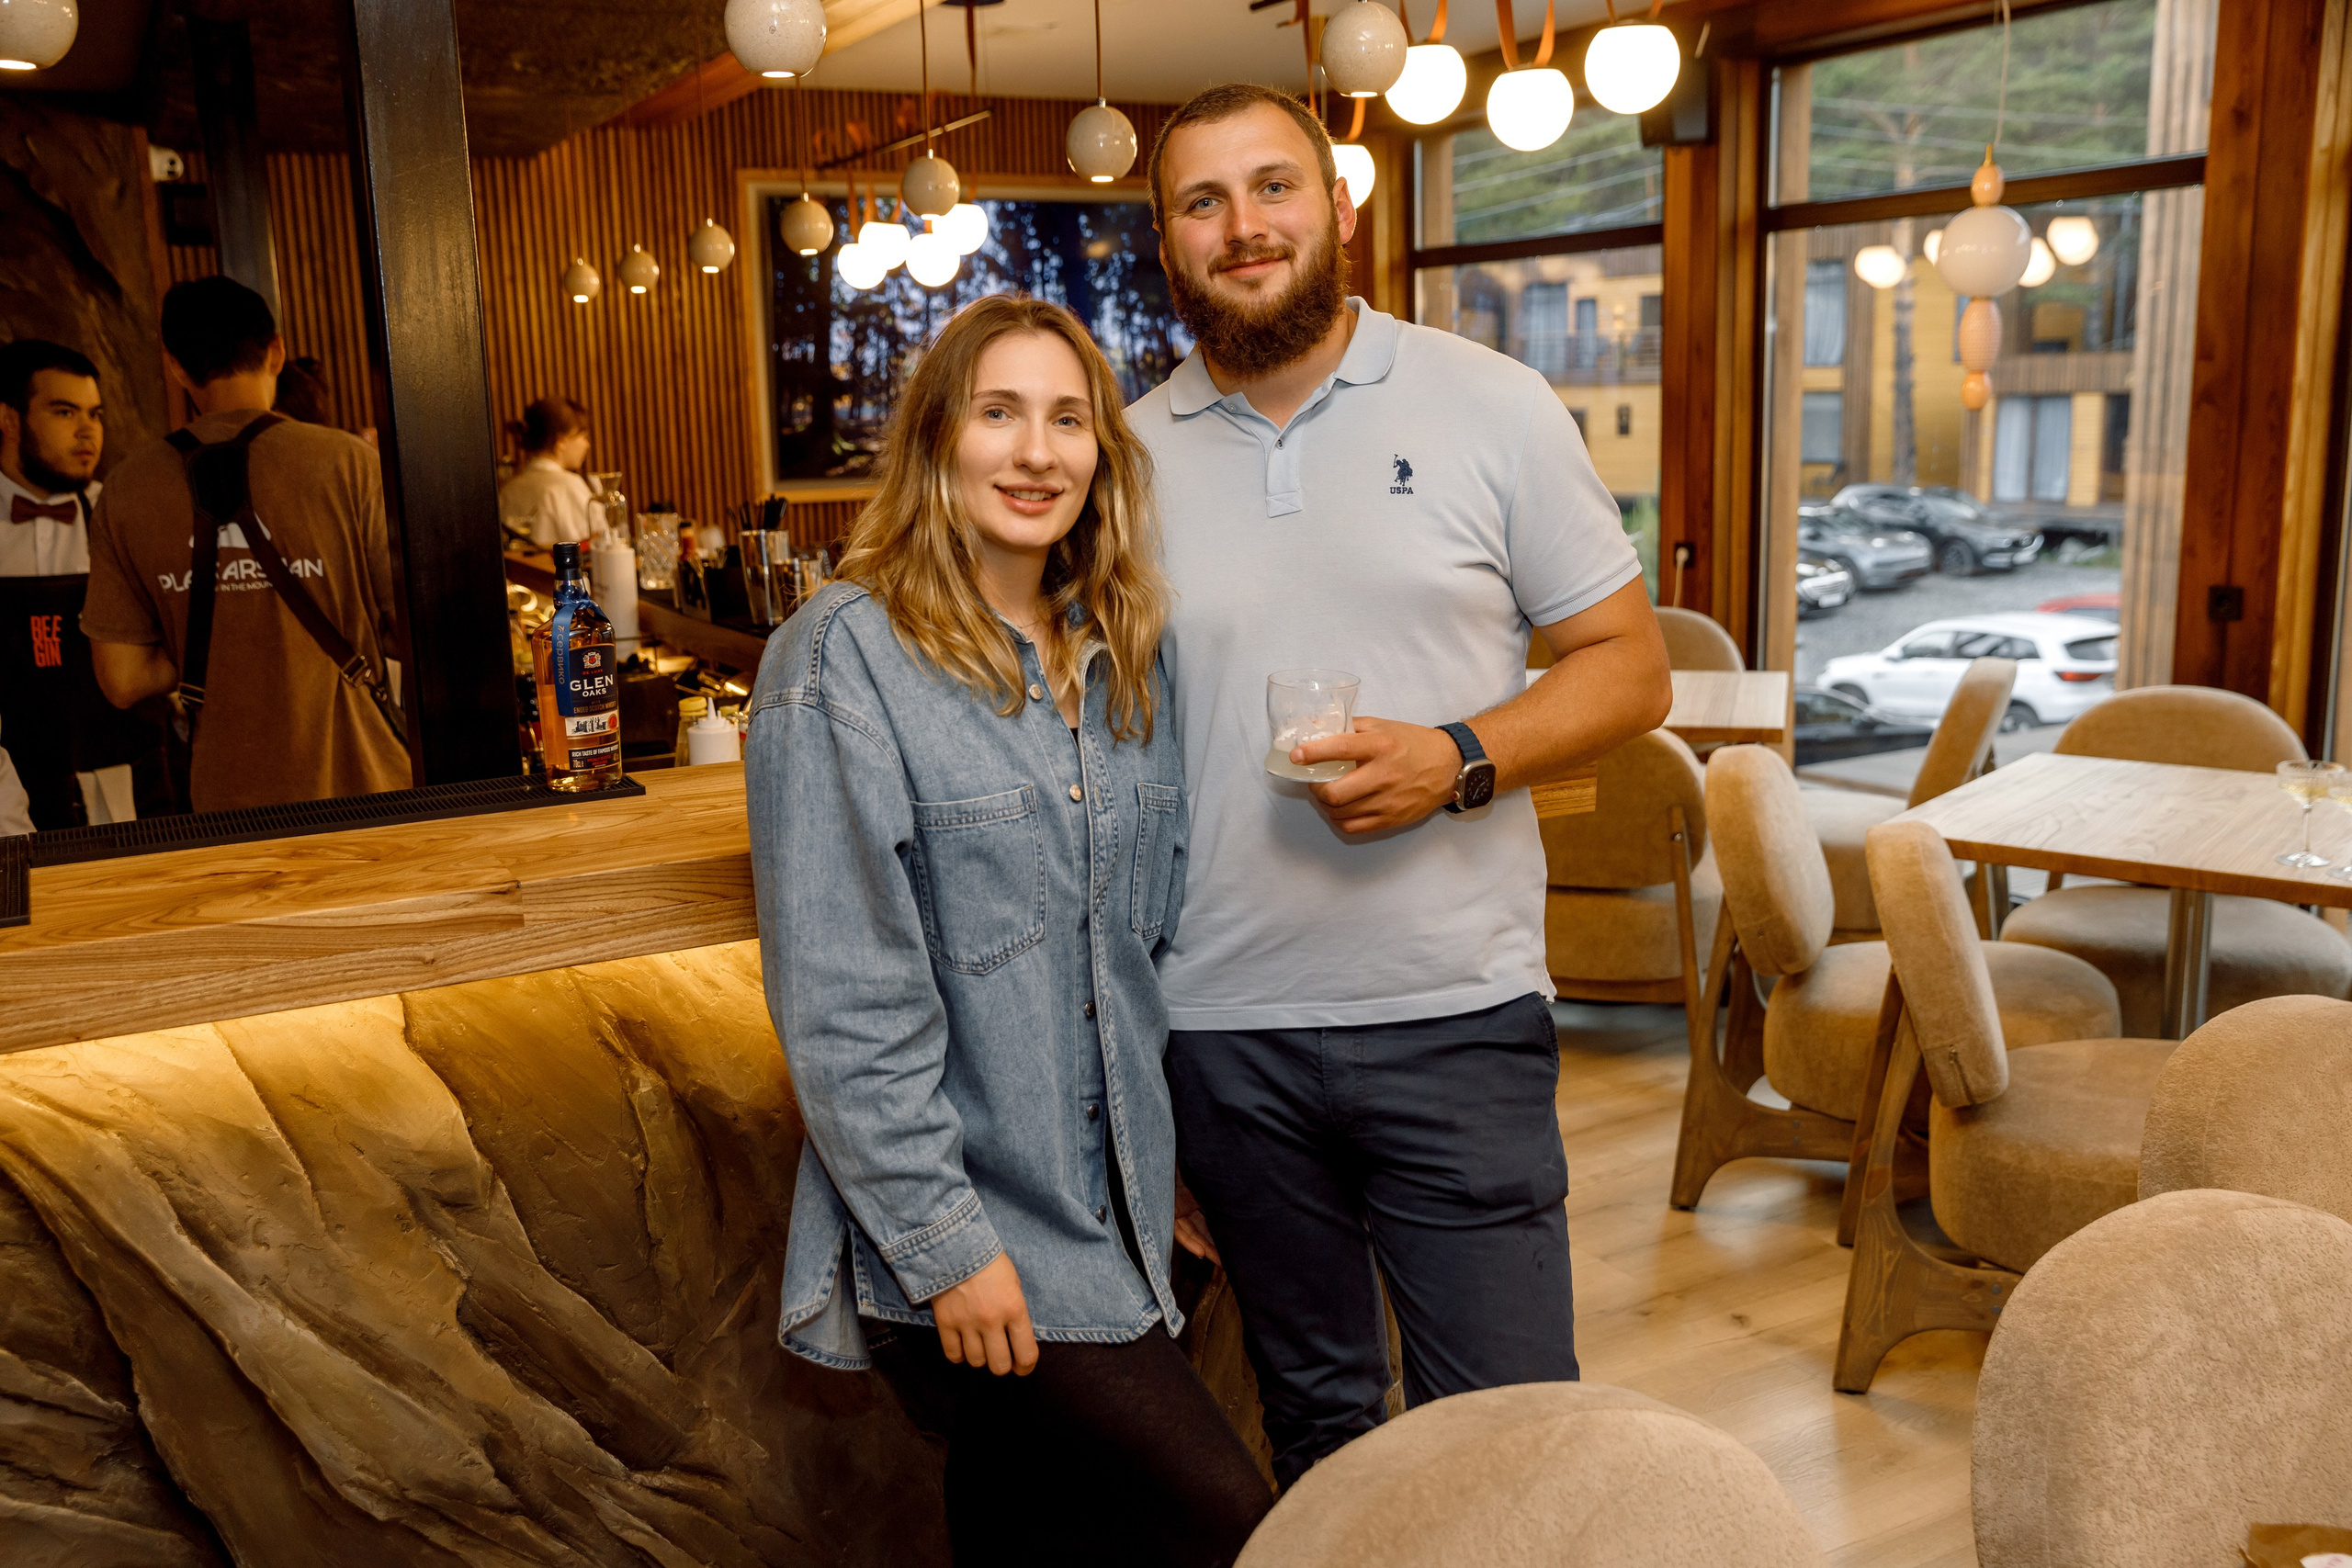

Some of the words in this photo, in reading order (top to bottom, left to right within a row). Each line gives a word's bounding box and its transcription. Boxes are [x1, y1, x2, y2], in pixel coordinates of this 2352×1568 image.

[33, 640, 62, 667] GIN
[570, 674, 614, 691] GLEN
[582, 687, 606, 697] OAKS
